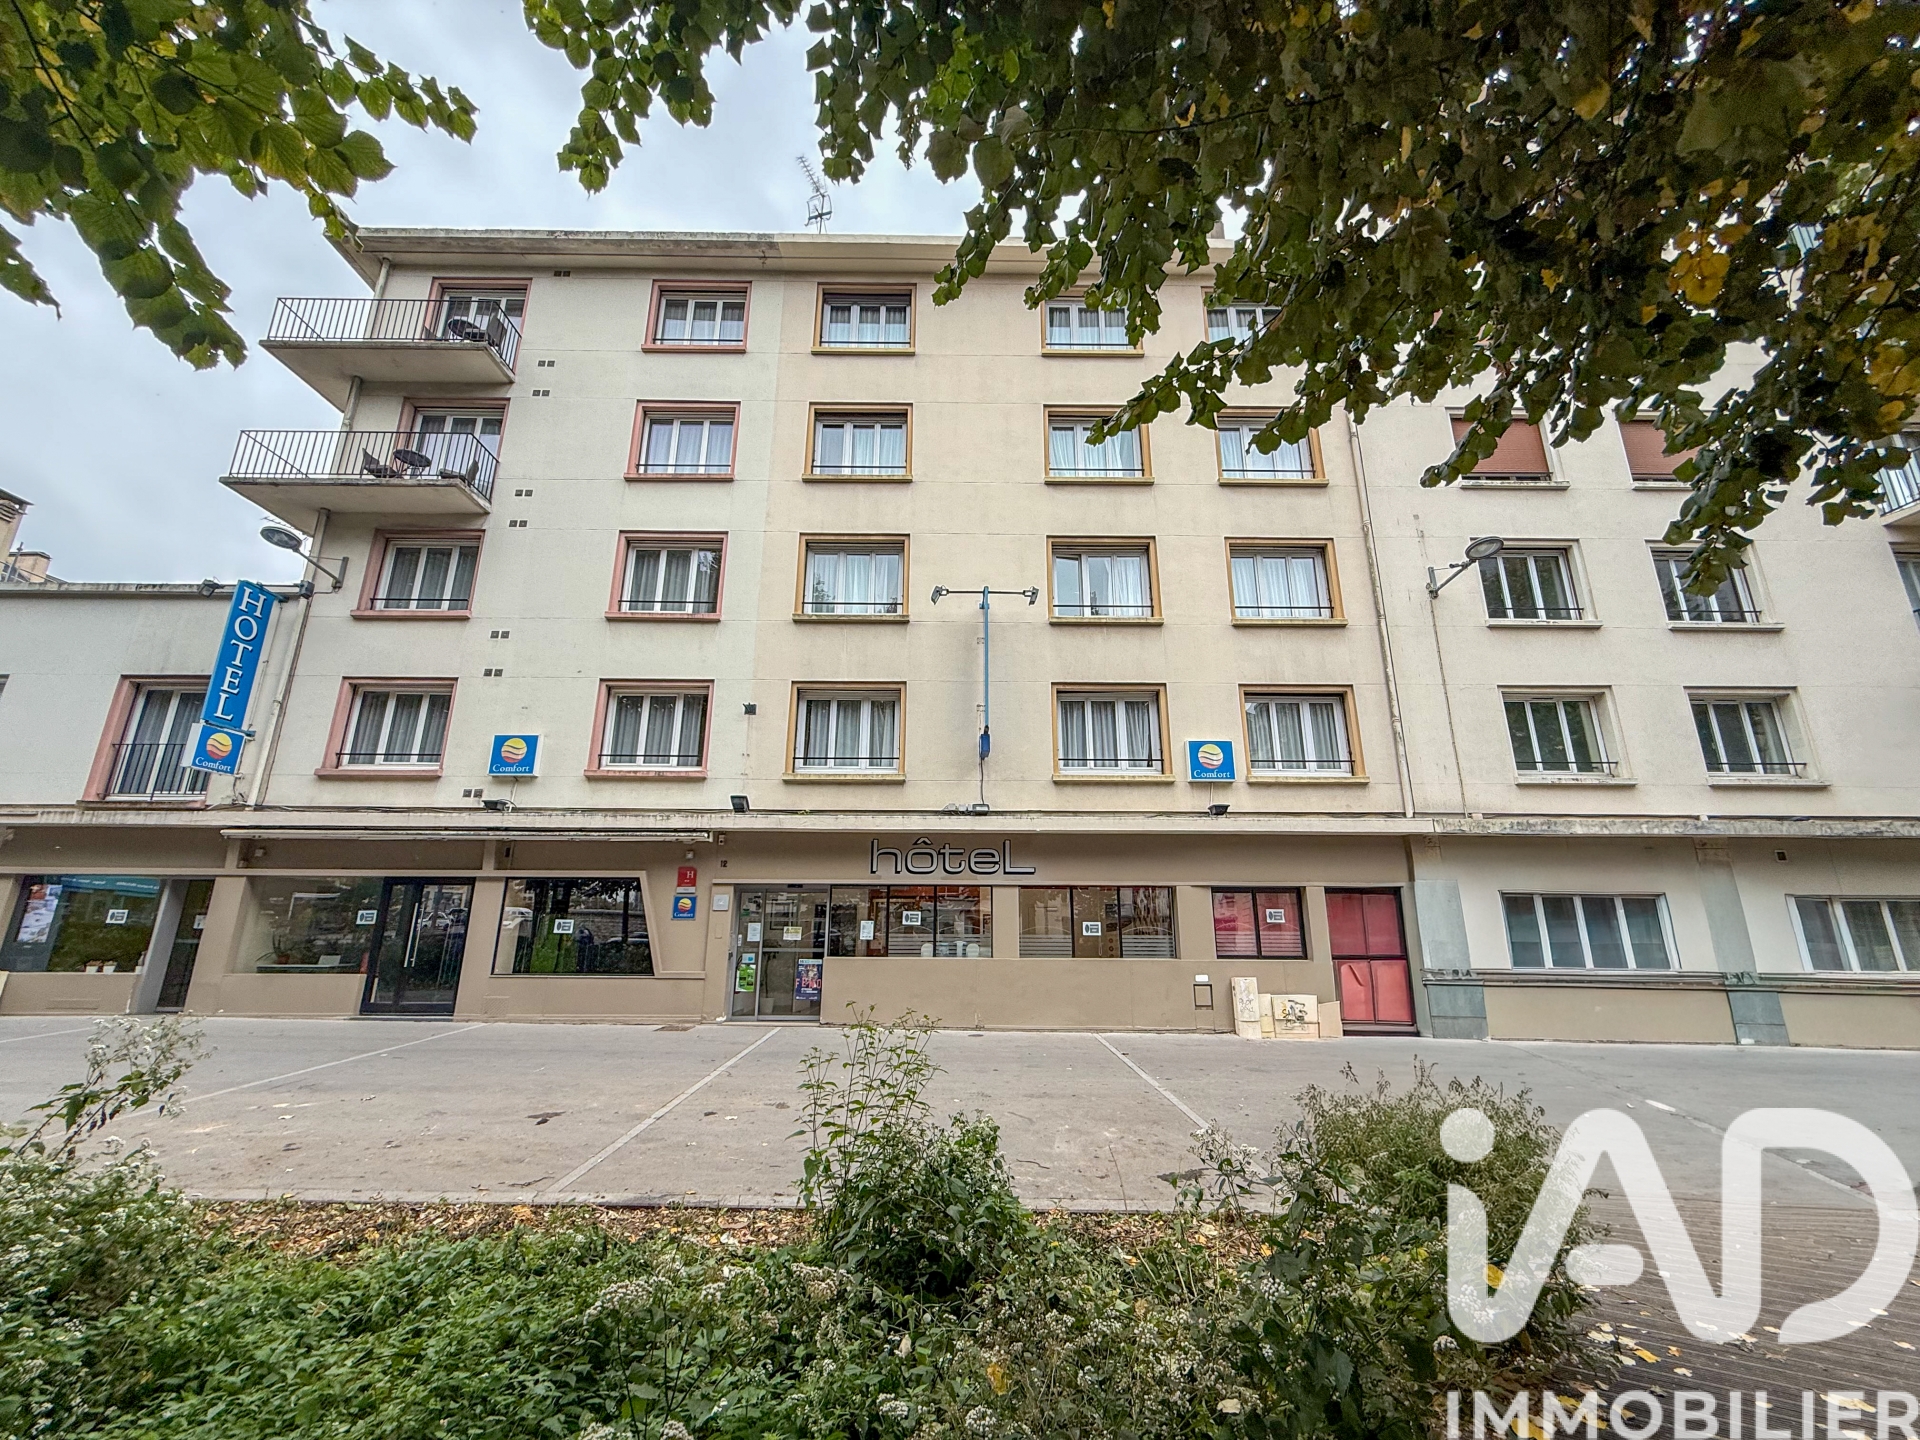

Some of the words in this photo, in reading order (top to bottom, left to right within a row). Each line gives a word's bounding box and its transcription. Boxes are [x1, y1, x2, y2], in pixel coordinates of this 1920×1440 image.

[213, 587, 267, 721] HOTEL
[195, 756, 231, 773] Comfort
[492, 763, 530, 773] Comfort
[1193, 769, 1231, 778] Comfort
[686, 870, 694, 879] H
